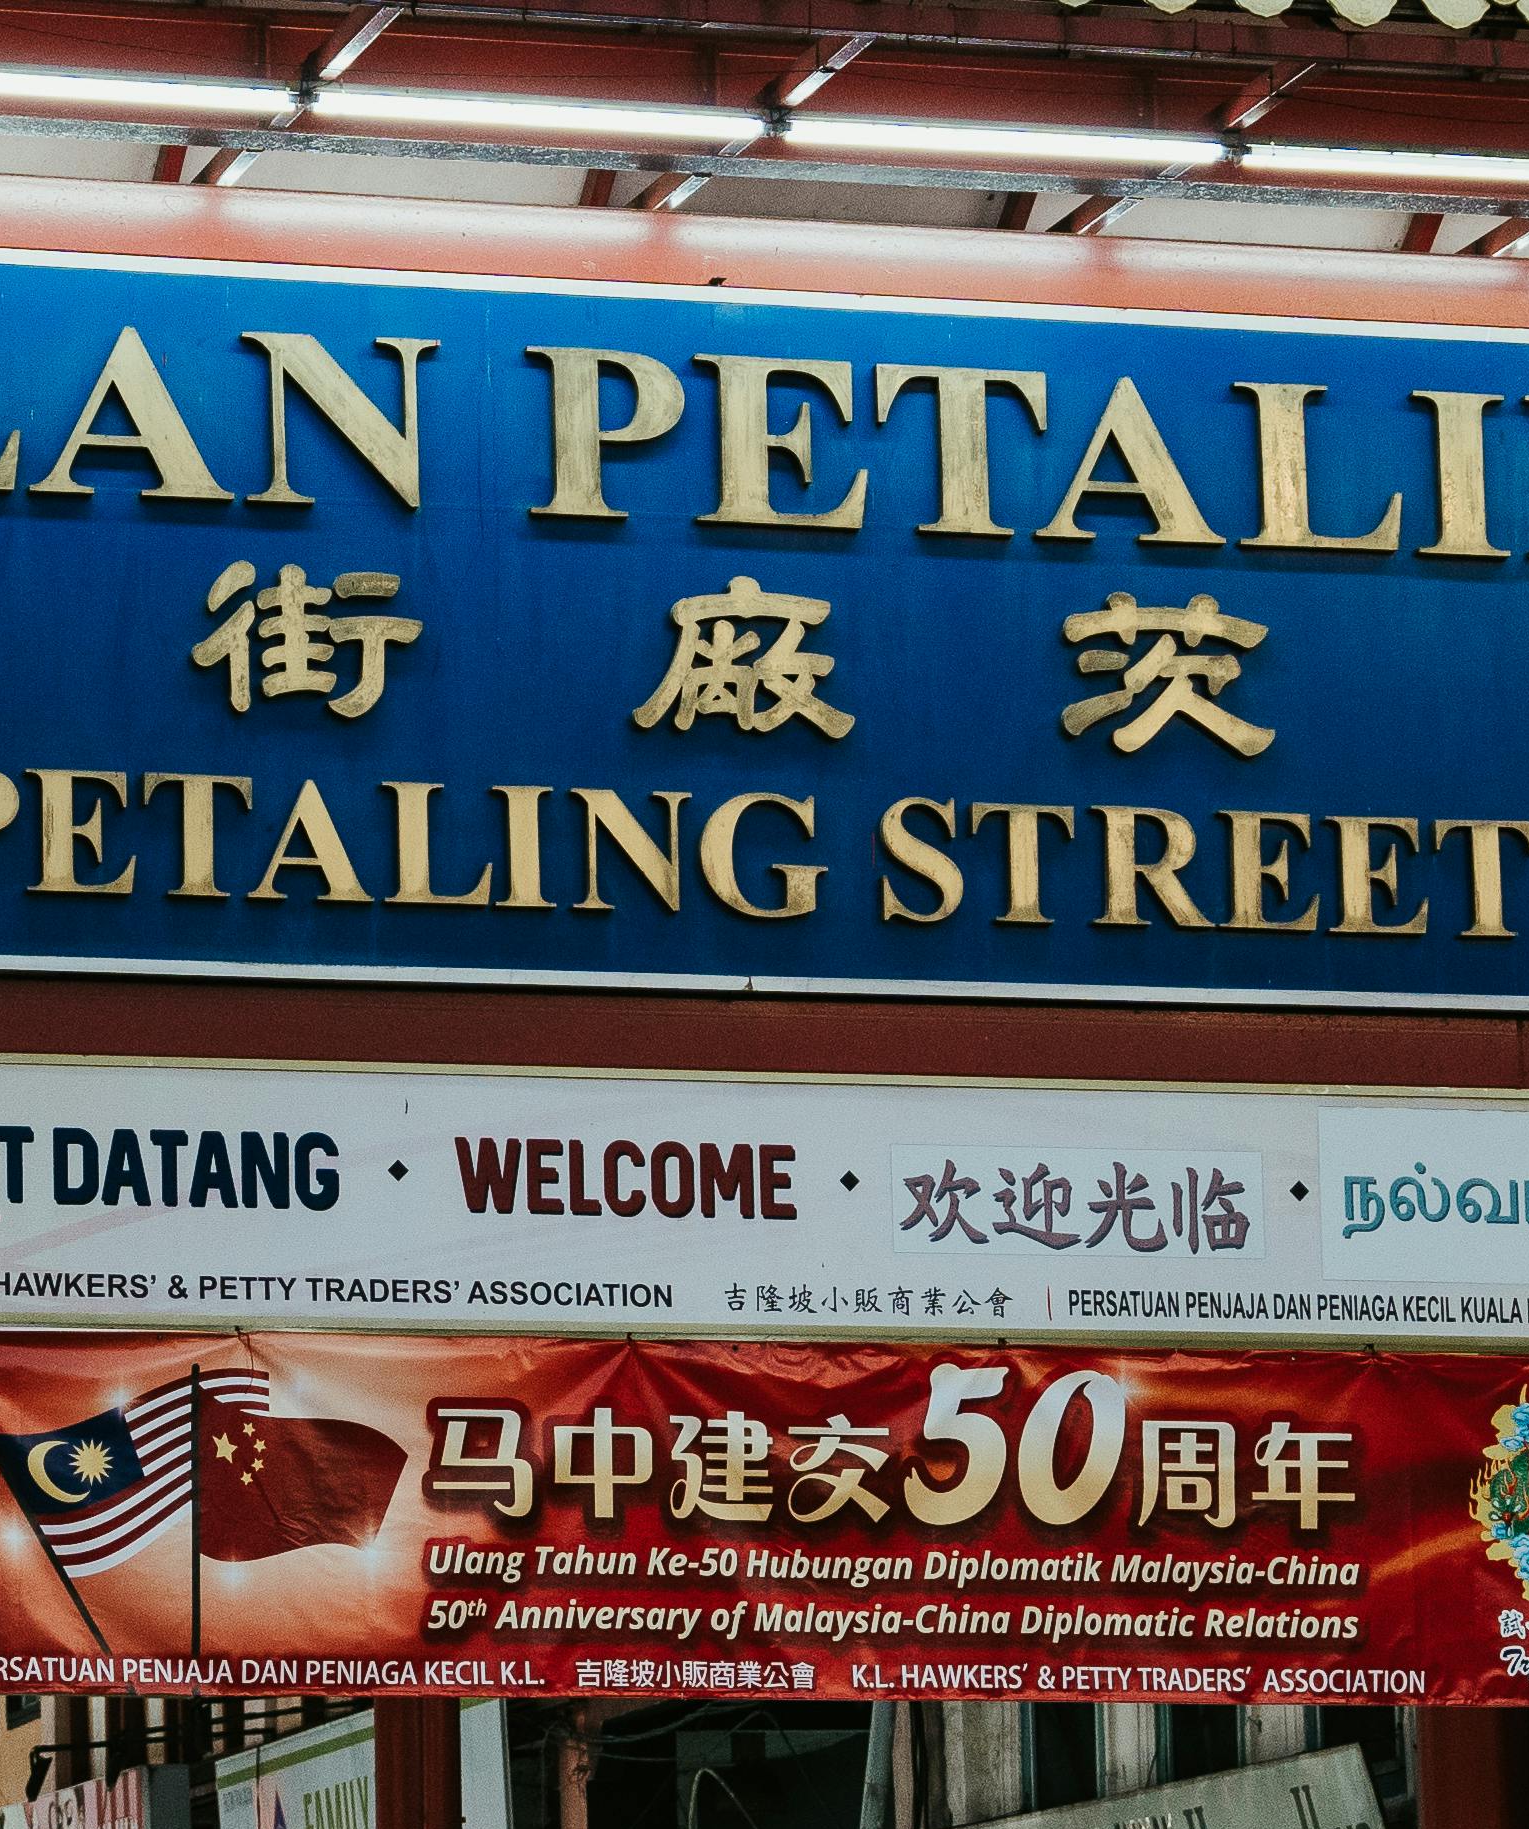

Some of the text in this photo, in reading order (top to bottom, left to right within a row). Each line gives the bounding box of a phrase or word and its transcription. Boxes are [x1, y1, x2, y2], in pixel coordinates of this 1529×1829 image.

[53, 1128, 341, 1213] DATANG
[453, 1134, 799, 1221] WELCOME
[900, 1157, 1250, 1256] 欢迎光临
[168, 1275, 190, 1301] &
[200, 1276, 298, 1302] PETTY
[306, 1278, 461, 1305] TRADERS'
[468, 1281, 674, 1309] ASSOCIATION
[725, 1283, 1014, 1320] 吉隆坡小販商業公會
[1069, 1290, 1181, 1319] PERSATUAN
[1186, 1292, 1270, 1321] PENJAJA
[1274, 1294, 1313, 1321] DAN
[1317, 1294, 1400, 1323] PENIAGA
[1403, 1296, 1458, 1324] KECIL
[1461, 1297, 1524, 1325] KUALA
[430, 1362, 1359, 1530] 马中建交50周年
[429, 1544, 1361, 1593] Ulang Tahun Ke-50 Hubungan Diplomatik Malaysia-China
[495, 1599, 703, 1641] Anniversary
[711, 1601, 749, 1641] of
[754, 1603, 1012, 1643] Malaysia-China
[1021, 1605, 1197, 1645] Diplomatic
[1205, 1608, 1360, 1640] Relations
[122, 1658, 235, 1686] PENJAJA
[242, 1660, 299, 1685] DAN
[306, 1661, 419, 1686] PENIAGA
[425, 1661, 496, 1687] KECIL
[501, 1661, 546, 1687] K.L.
[576, 1659, 816, 1690] 吉隆坡小販商業公會
[852, 1663, 1427, 1696] K.L. HAWKERS' & PETTY TRADERS' ASSOCIATION
